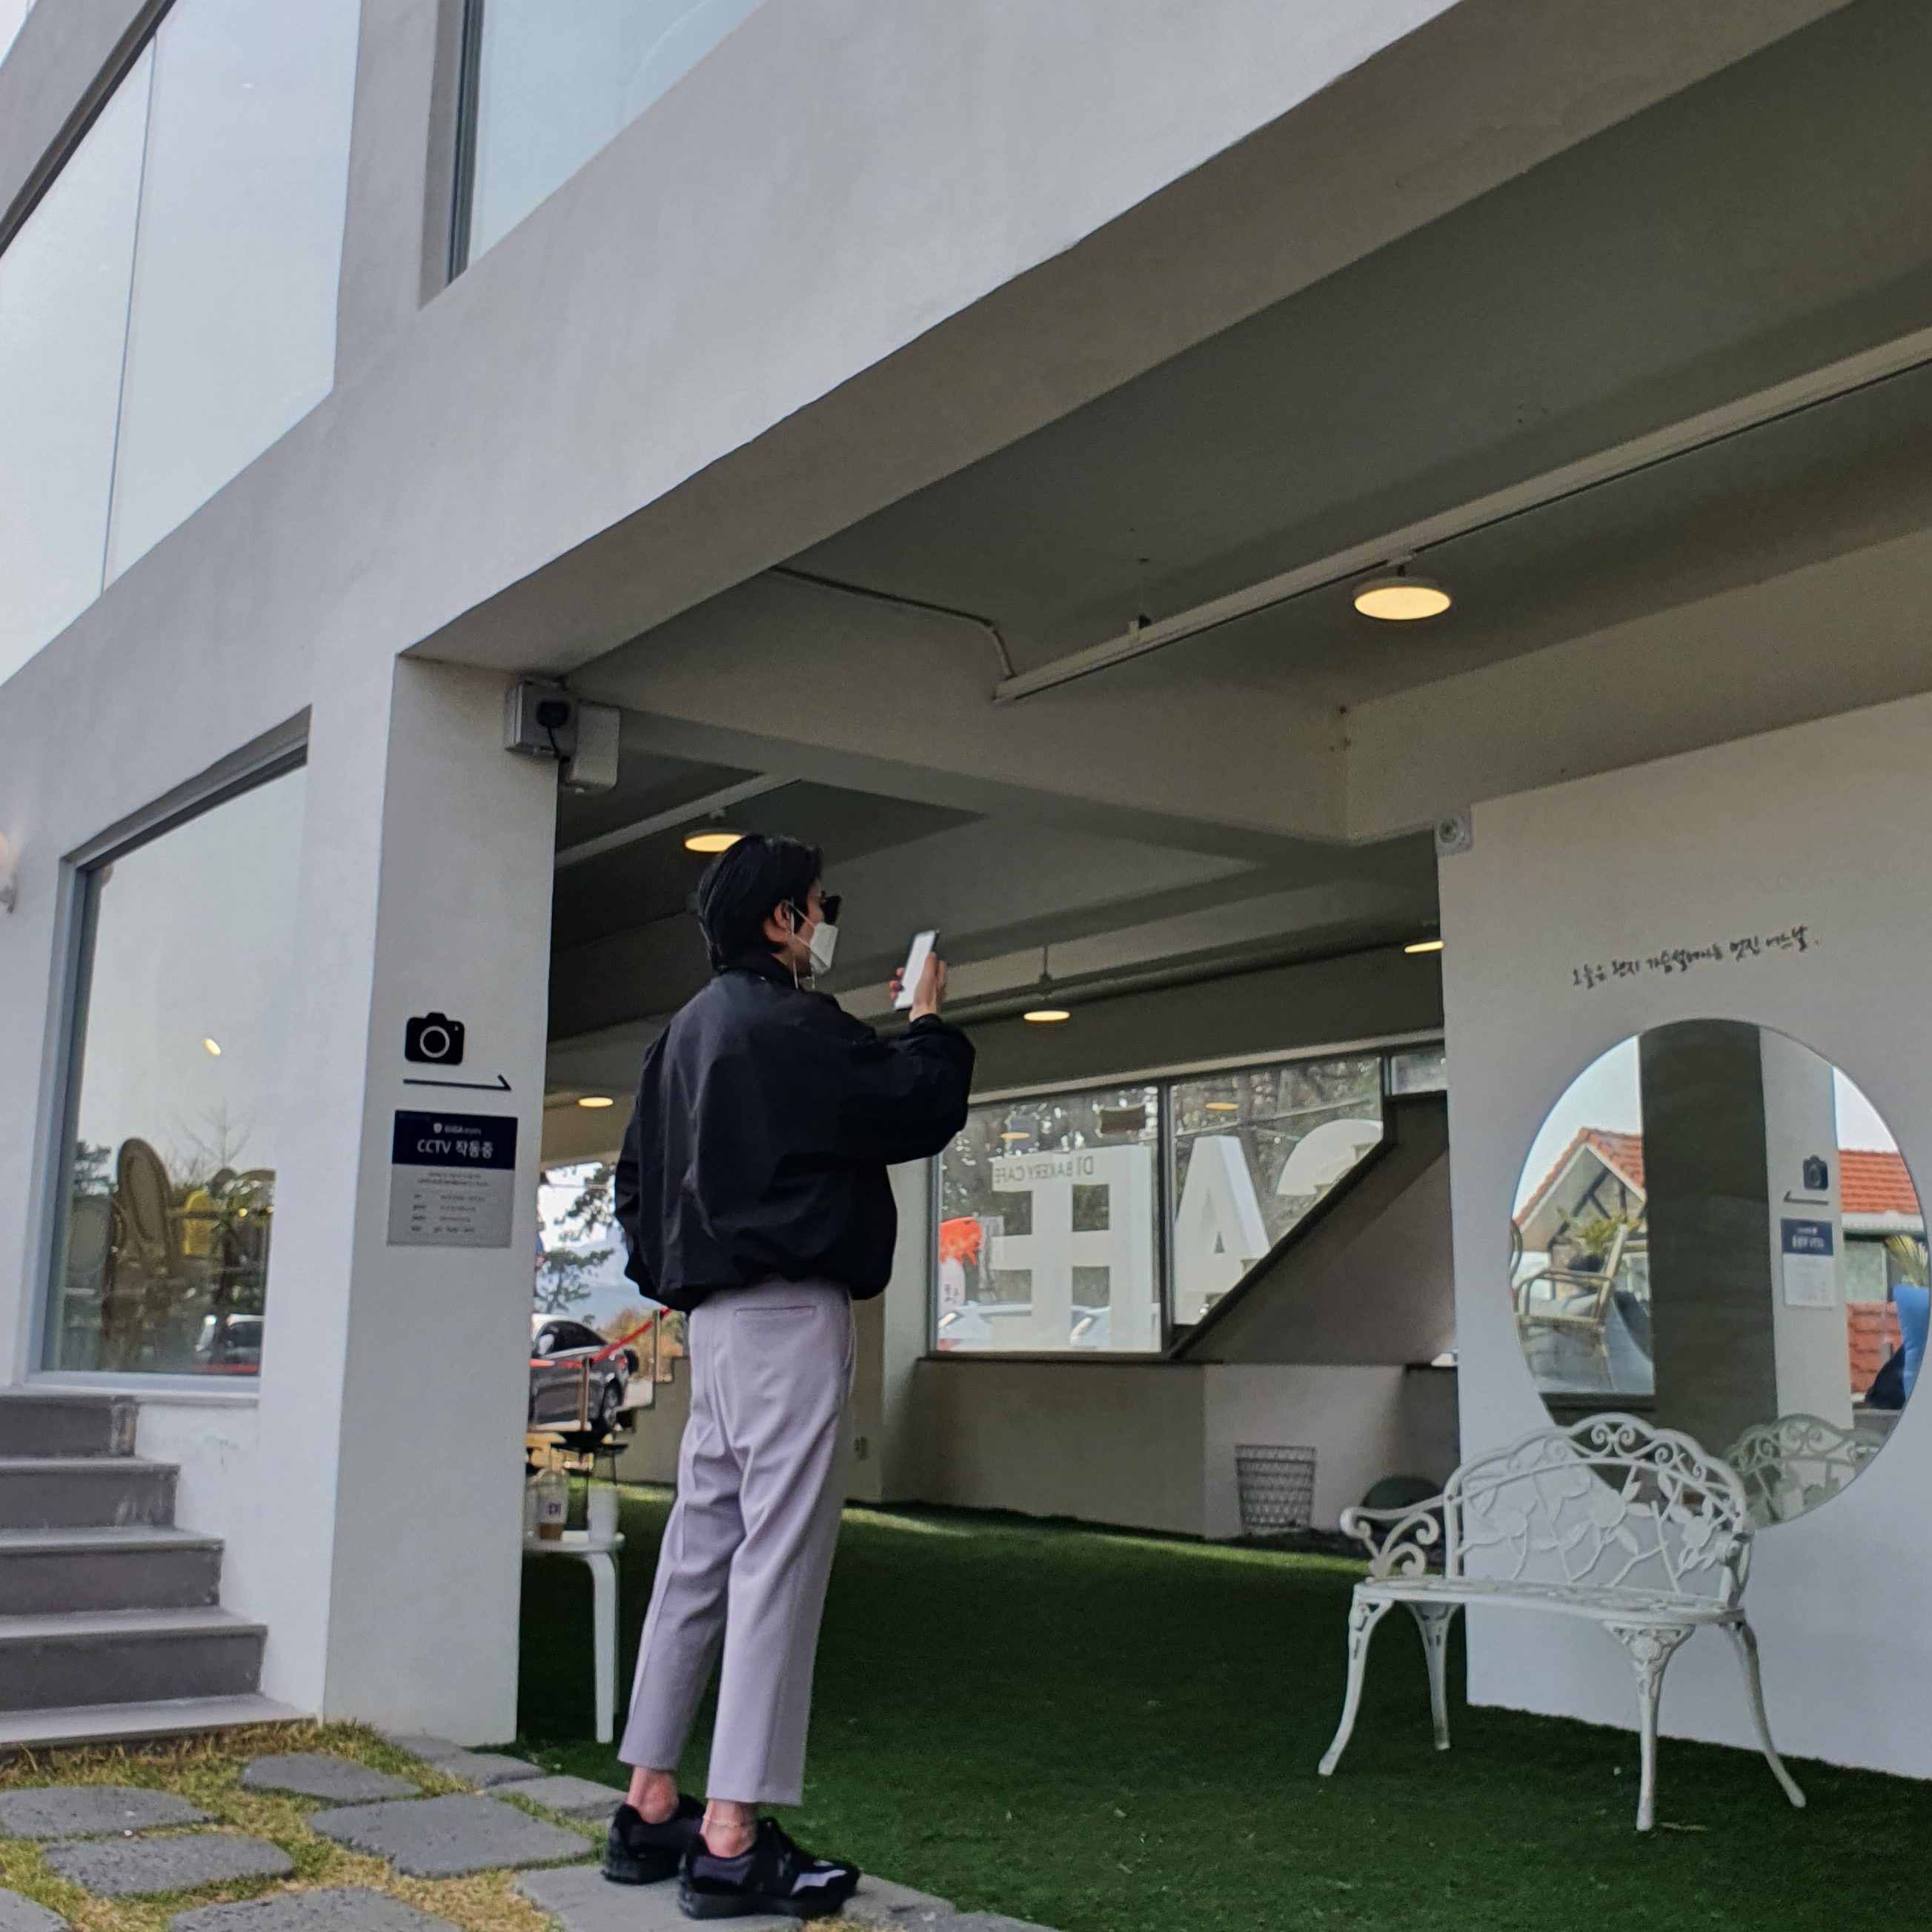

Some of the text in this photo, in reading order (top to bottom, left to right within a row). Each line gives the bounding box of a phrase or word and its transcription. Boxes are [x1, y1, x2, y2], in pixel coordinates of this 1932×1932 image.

[1729, 935, 1760, 962] 멋진
[416, 1138, 494, 1159] CCTV 작동중
